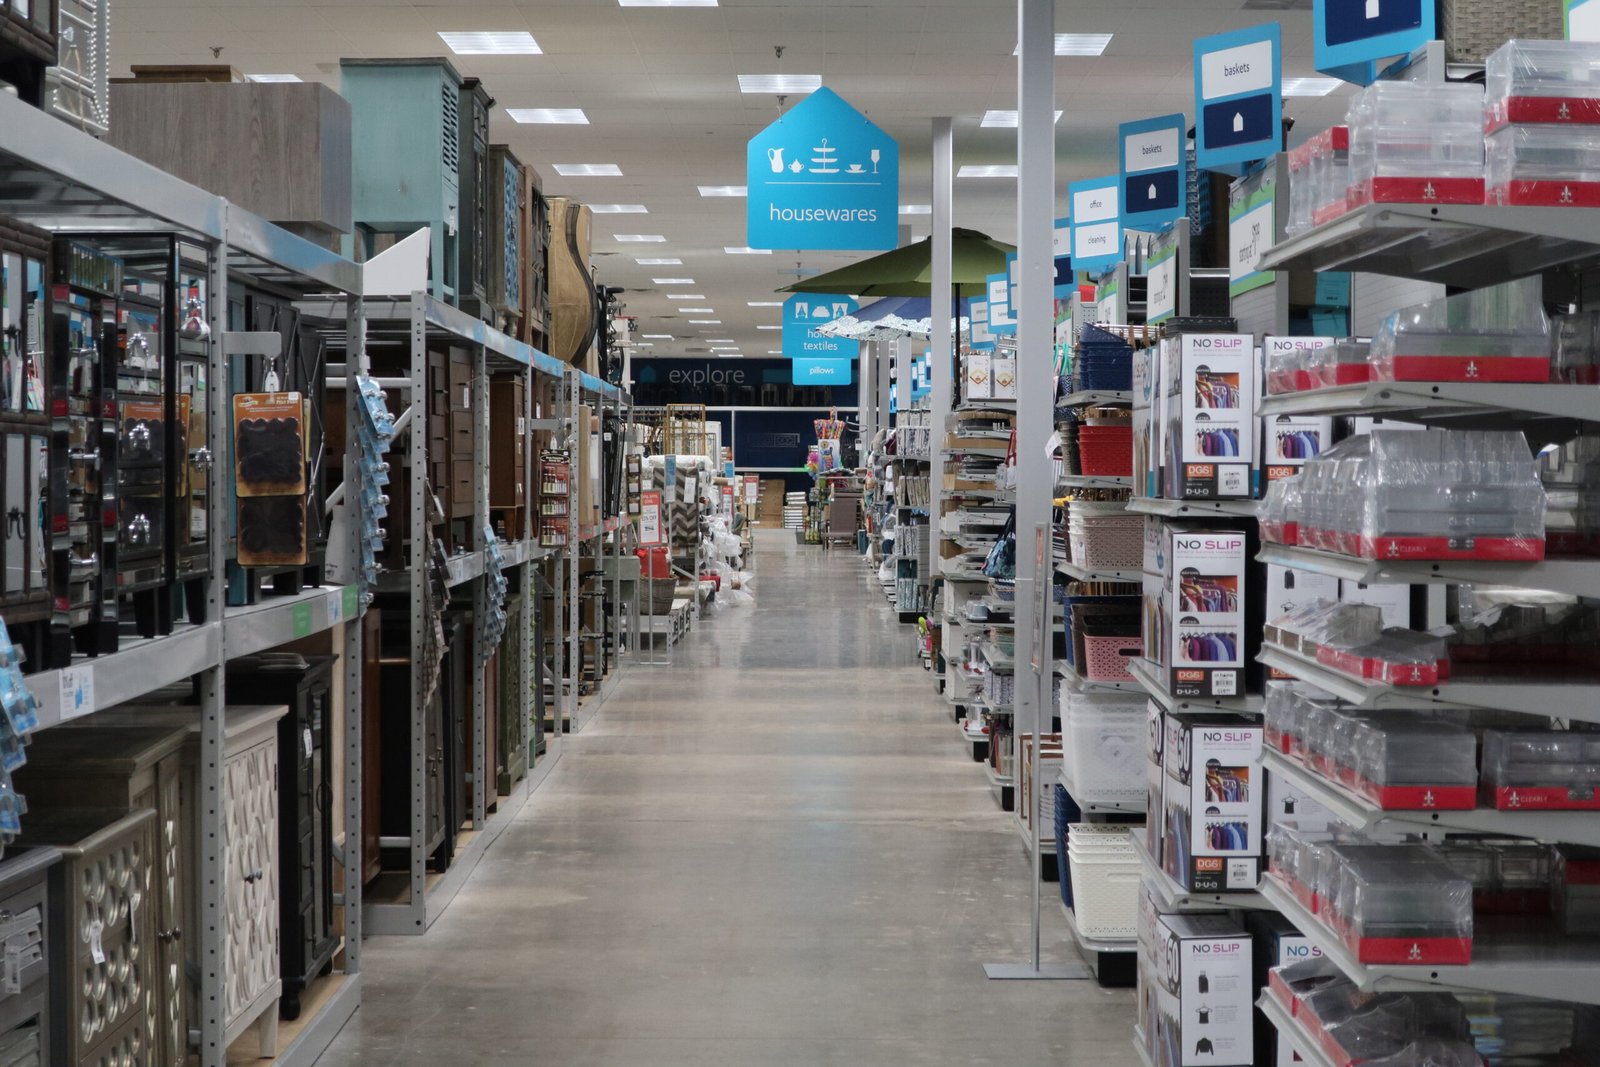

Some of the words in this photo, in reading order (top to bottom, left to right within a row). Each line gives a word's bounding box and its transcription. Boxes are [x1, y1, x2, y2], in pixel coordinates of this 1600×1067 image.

[1224, 63, 1250, 77] baskets
[1142, 144, 1162, 155] baskets
[1089, 200, 1102, 209] office
[770, 202, 877, 222] housewares
[1087, 234, 1107, 245] cleaning
[803, 341, 838, 351] textiles
[1193, 338, 1212, 348] NO
[1214, 338, 1242, 348] SLIP
[1274, 341, 1293, 350] NO
[1295, 341, 1323, 350] SLIP
[669, 362, 745, 387] explore
[809, 366, 834, 376] pillows
[1177, 540, 1201, 550] NO
[1204, 540, 1242, 550] SLIP
[1203, 732, 1222, 742] NO
[1224, 732, 1252, 742] SLIP
[1178, 728, 1190, 771] 50
[1192, 943, 1211, 953] NO
[1213, 943, 1240, 953] SLIP
[1287, 945, 1309, 956] NO
[1167, 937, 1179, 983] 50
